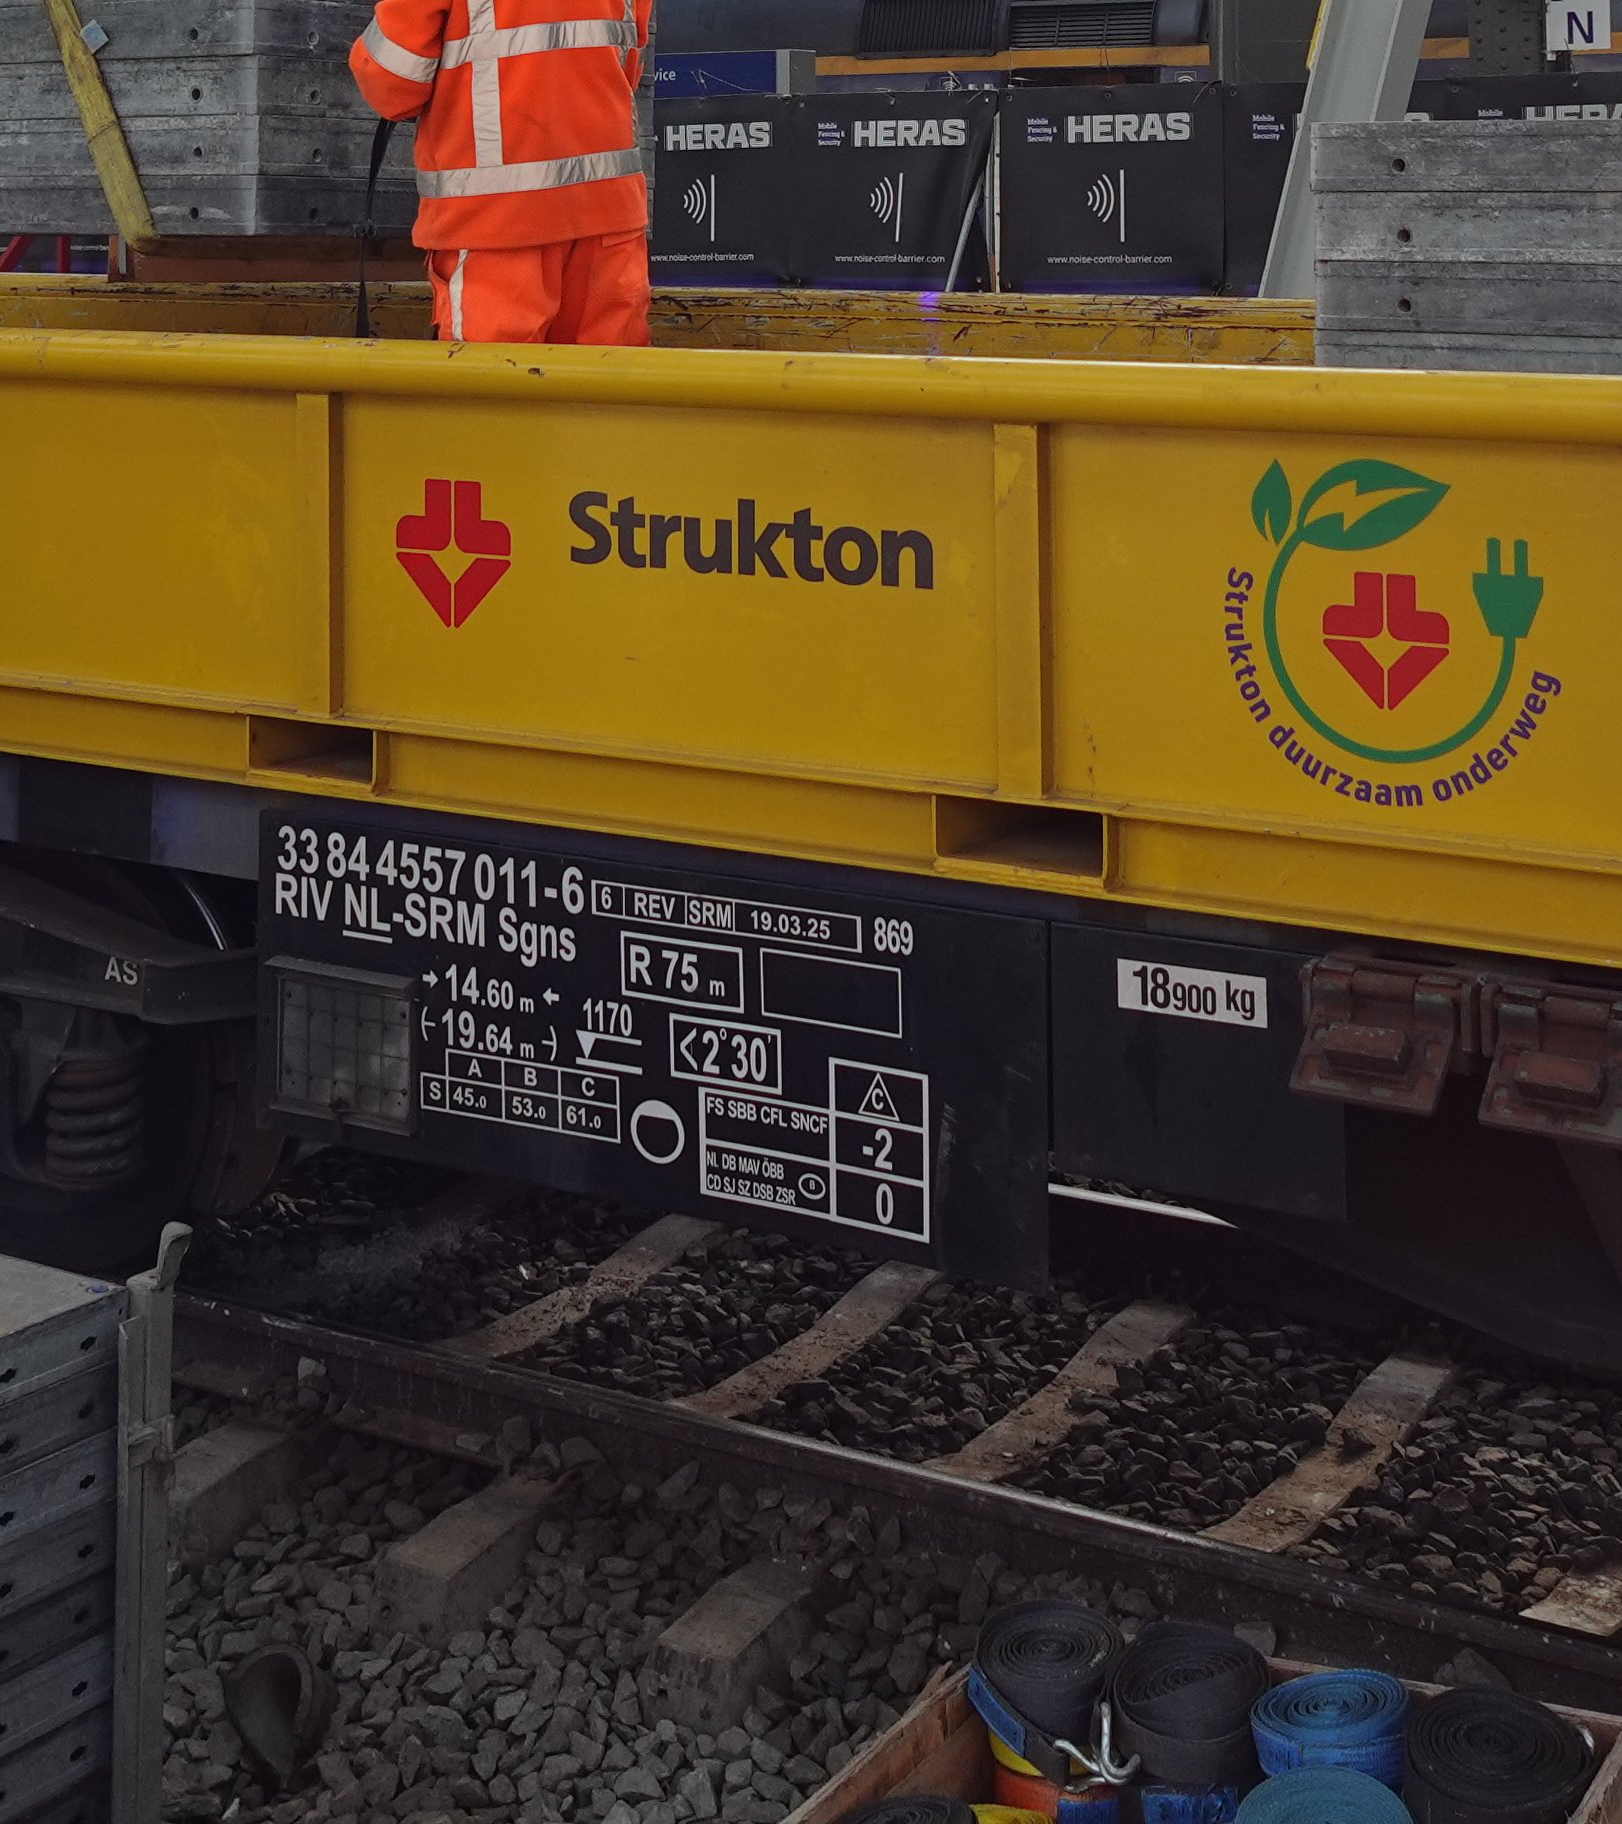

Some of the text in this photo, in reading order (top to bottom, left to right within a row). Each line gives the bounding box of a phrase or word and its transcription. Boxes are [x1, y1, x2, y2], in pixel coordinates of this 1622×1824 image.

[1567, 11, 1594, 45] N
[654, 68, 676, 81] vice
[666, 121, 770, 151] HERAS
[854, 119, 965, 148] HERAS
[1067, 112, 1190, 144] HERAS
[650, 252, 754, 262] www.noise-control-barrier.com
[834, 254, 945, 263] www.noise-control-barrier.com
[1047, 254, 1172, 264] www.noise-control-barrier.com
[568, 490, 935, 590] Strukton
[1223, 567, 1562, 808] Strukton duurzaam onderweg
[278, 826, 585, 915] 33 84 4557 011-6
[275, 873, 577, 967] RIV NL-SRM Sgns
[601, 887, 914, 956] 6 REV SRM 19.03.25 869
[104, 956, 138, 986] AS
[445, 963, 535, 1014] 14.60 m
[629, 944, 725, 997] R 75 m
[582, 997, 633, 1037] 1170
[1226, 979, 1255, 1021] kg
[441, 1008, 535, 1059] 19.64 m
[468, 1058, 595, 1097] A B C
[429, 1081, 602, 1130] S 45.0 53.0 61.0
[706, 1096, 828, 1135] FS SBB CFL SNCF
[871, 1087, 884, 1111] C
[707, 1151, 719, 1168] NL
[722, 1153, 736, 1171] DB
[739, 1156, 760, 1175] MAV
[862, 1128, 893, 1171] -2
[707, 1173, 796, 1205] CD SJ SZ DSB ZSR
[875, 1182, 894, 1225] 0
